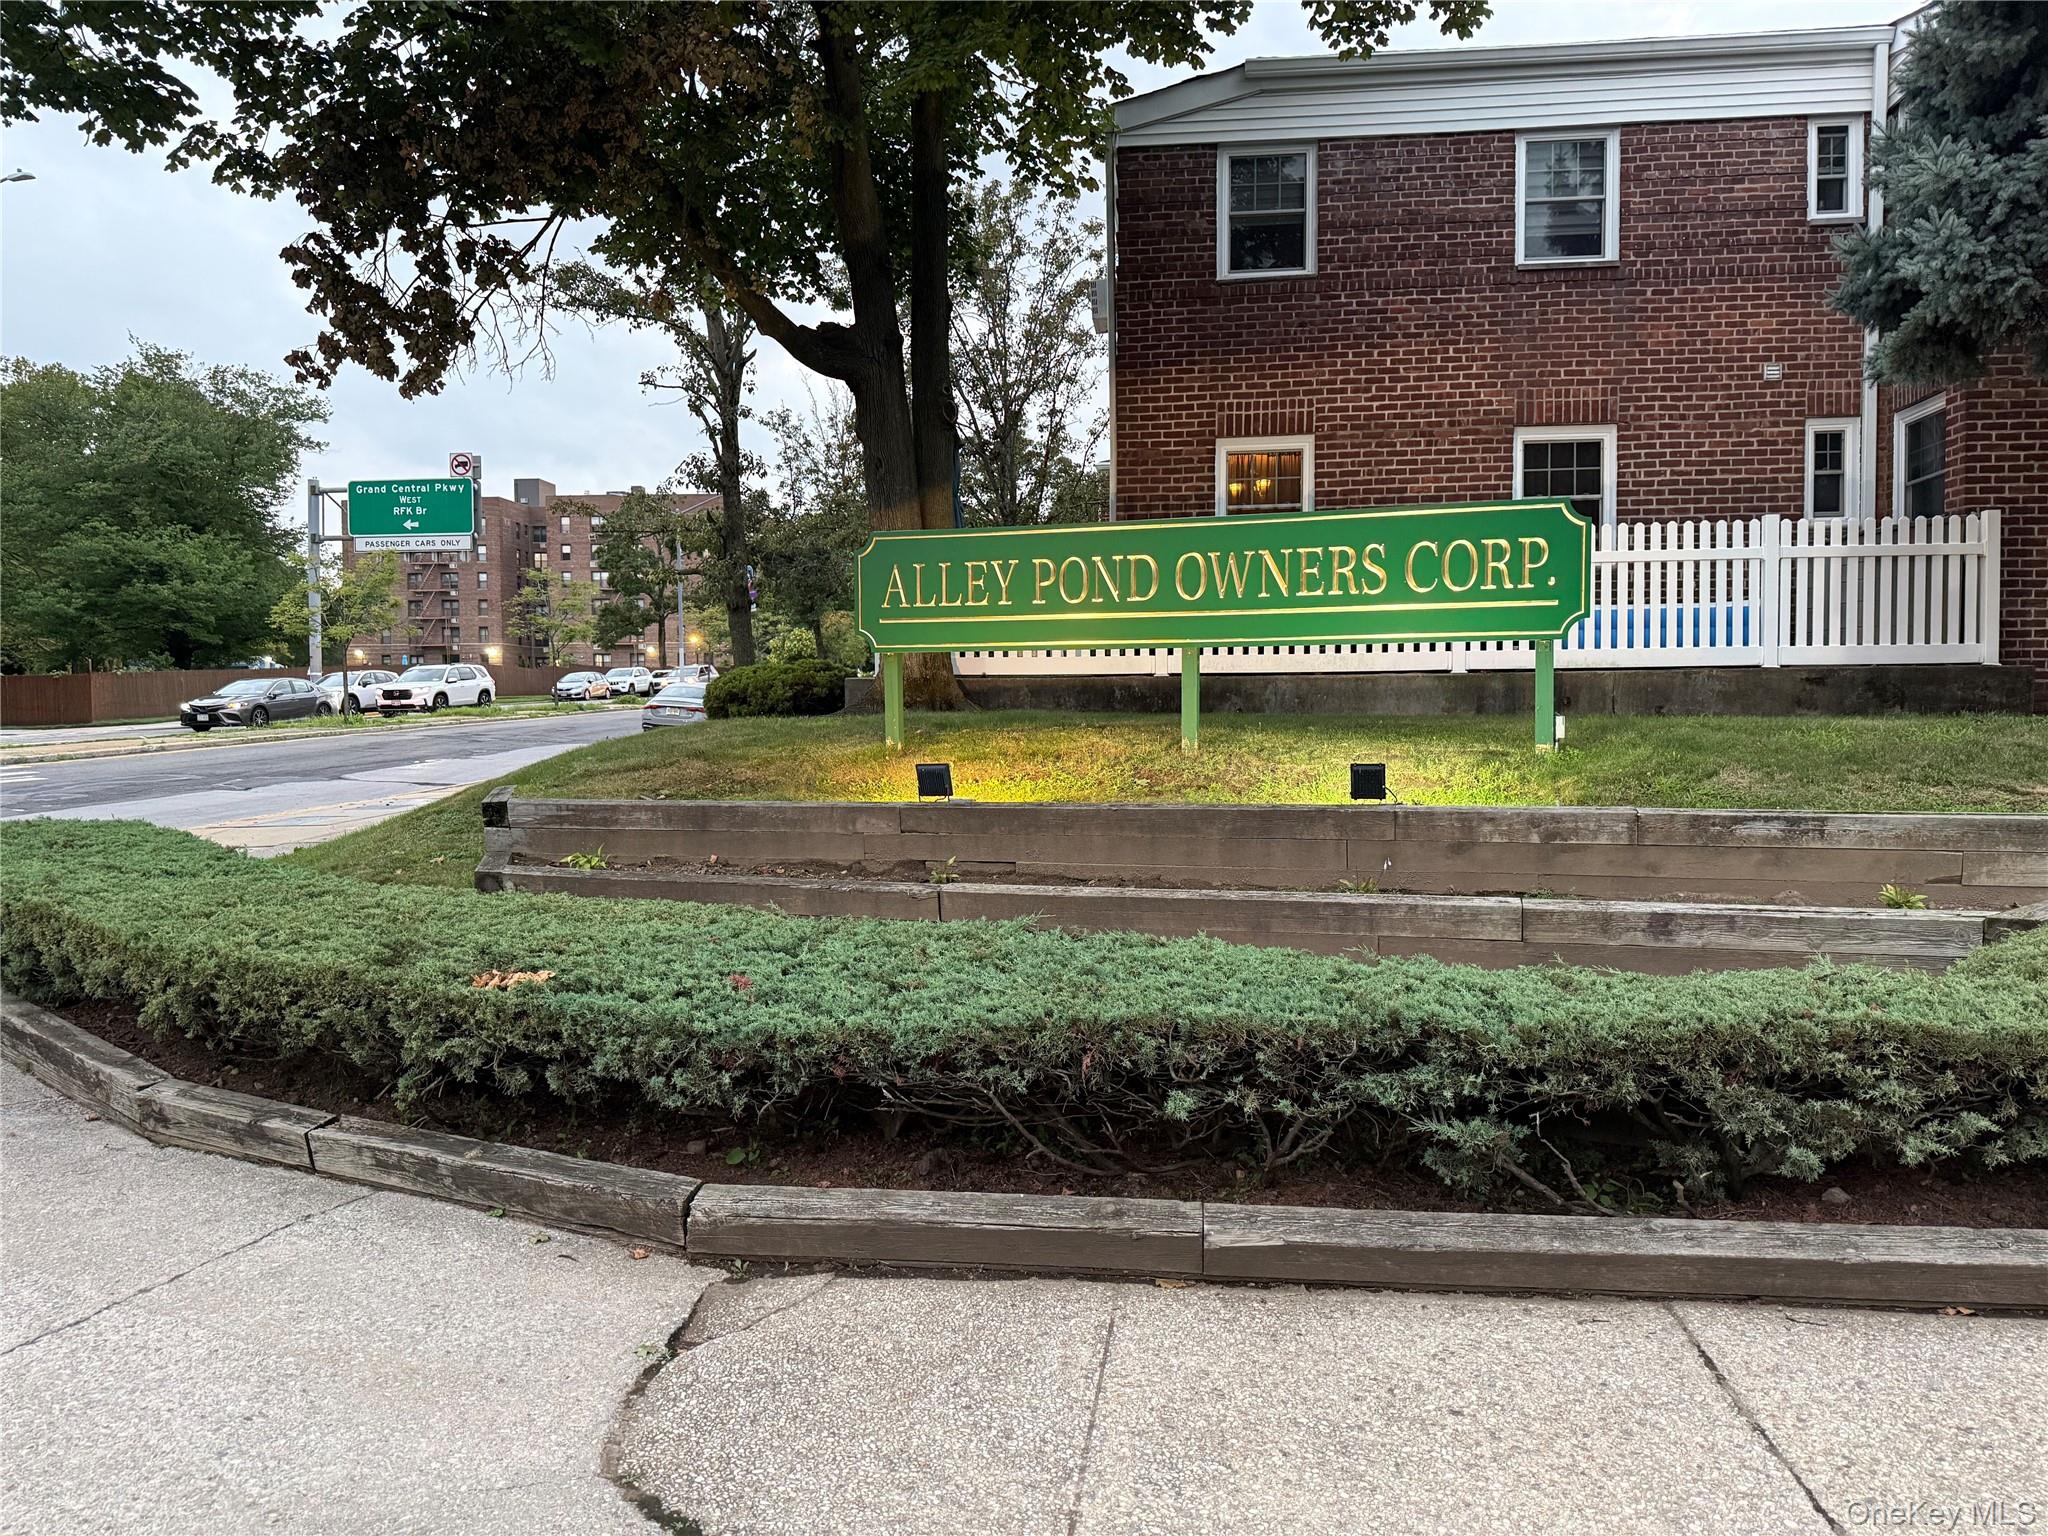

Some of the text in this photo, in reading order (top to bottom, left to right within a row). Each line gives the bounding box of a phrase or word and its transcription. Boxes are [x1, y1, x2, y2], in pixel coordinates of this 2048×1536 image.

[356, 483, 465, 494] Grand Central Pkwy
[399, 496, 422, 504] WEST
[393, 506, 428, 515] RFK Br
[365, 539, 461, 548] PASSENGER CARS ONLY
[881, 537, 1556, 608] ALLEY POND OWNERS CORP.
